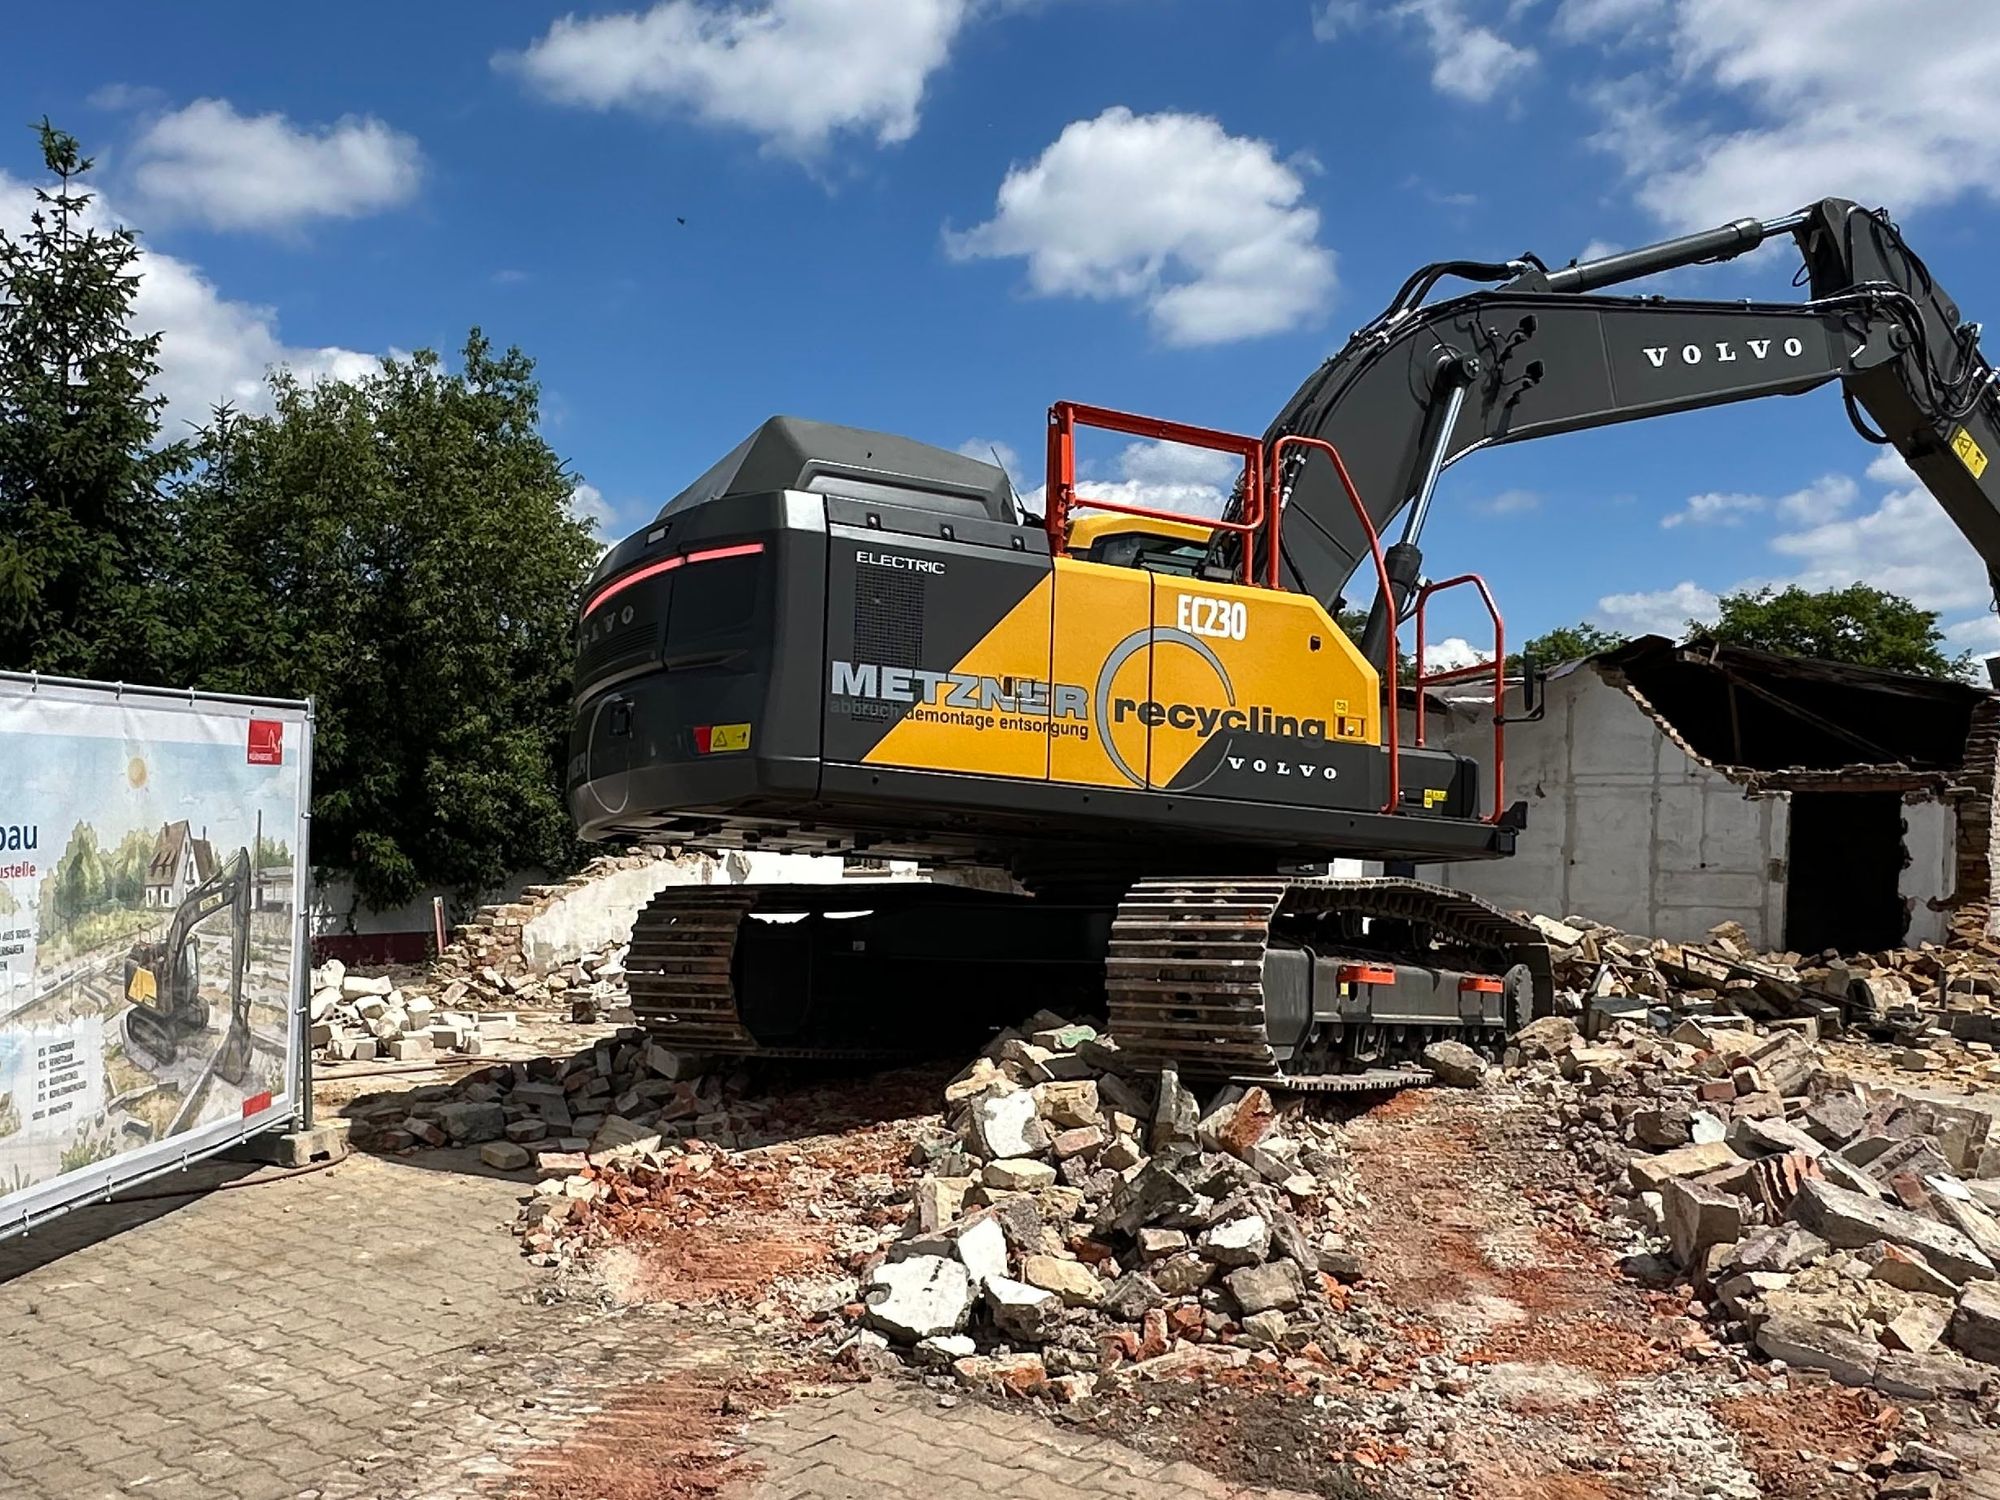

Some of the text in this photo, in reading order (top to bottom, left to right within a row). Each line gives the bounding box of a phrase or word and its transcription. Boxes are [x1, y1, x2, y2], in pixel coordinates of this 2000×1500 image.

[1643, 337, 1804, 368] VOLVO
[855, 550, 946, 576] ELECTRIC
[1177, 594, 1248, 641] EC230
[831, 660, 1090, 721] METZNER
[830, 698, 1090, 741] abbruch demontage entsorgung
[1113, 697, 1327, 748] recycling
[1227, 756, 1338, 781] VOLVO
